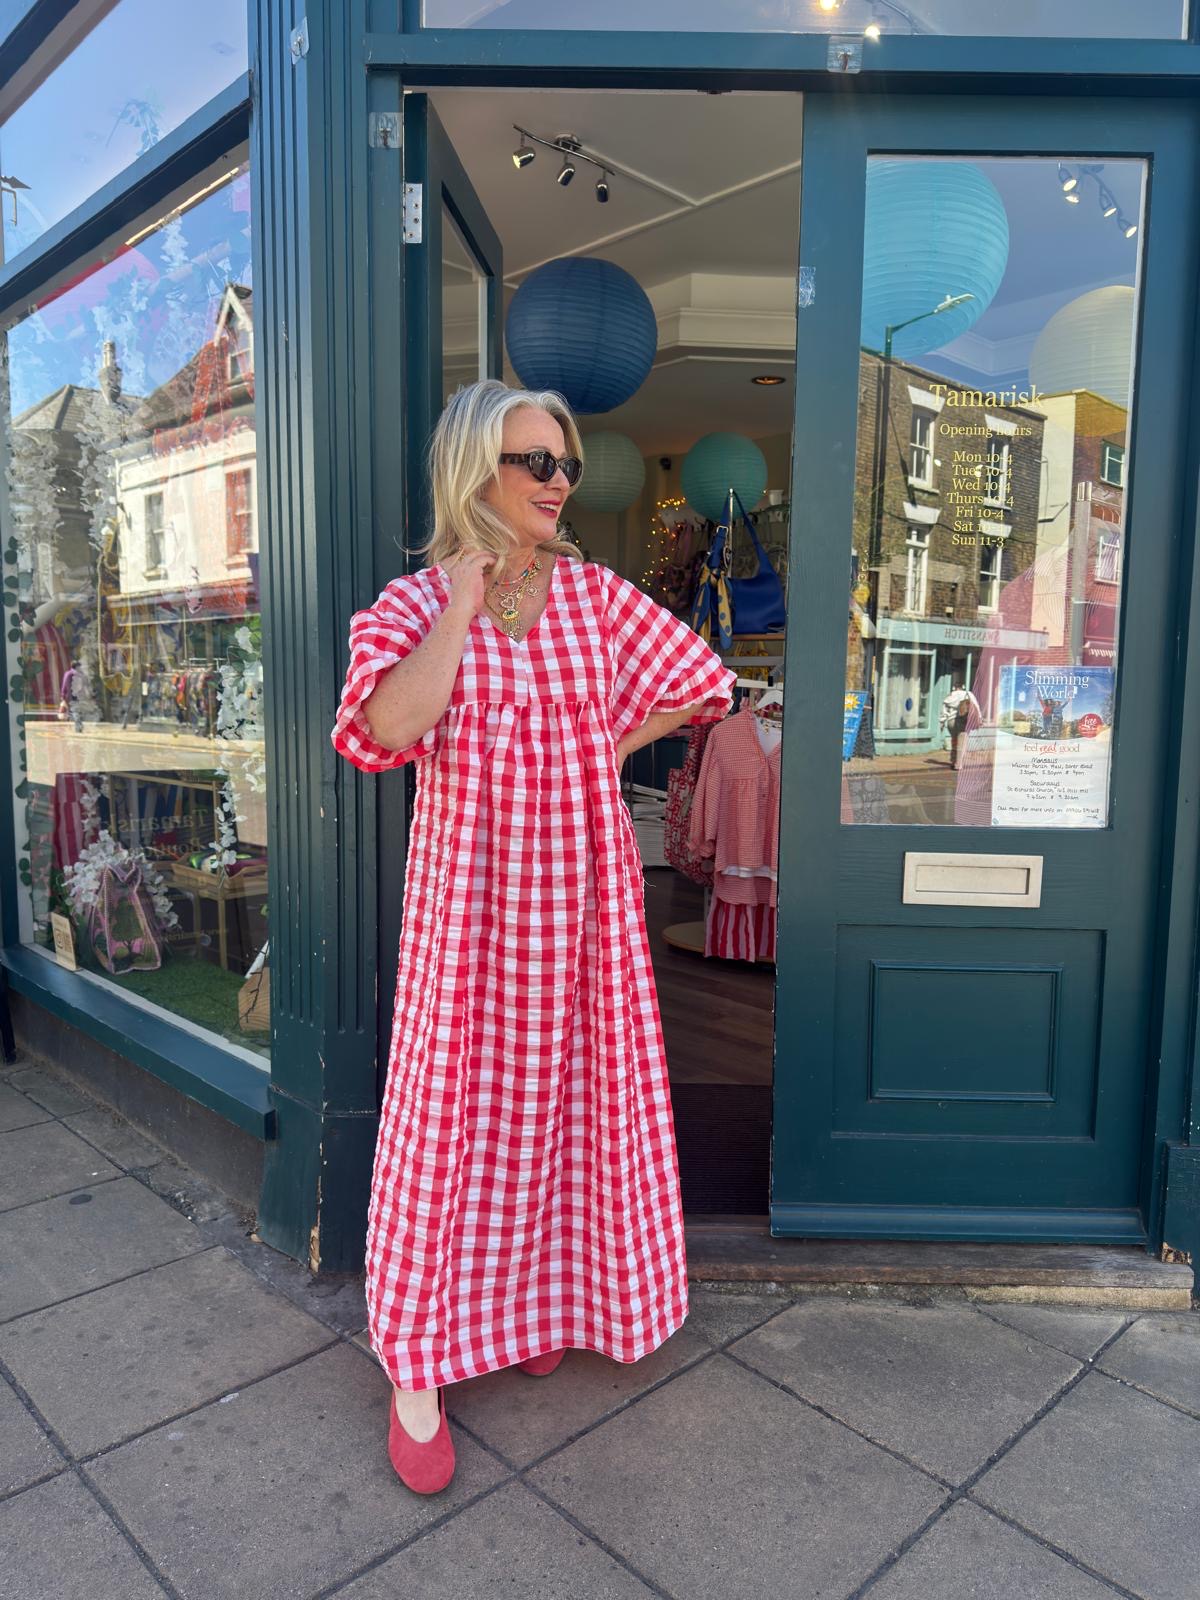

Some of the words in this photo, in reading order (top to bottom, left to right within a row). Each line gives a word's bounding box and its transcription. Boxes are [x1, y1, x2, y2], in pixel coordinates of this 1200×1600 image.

[929, 384, 1044, 408] Tamarisk
[940, 423, 993, 438] Opening
[996, 424, 1032, 437] hours
[953, 450, 982, 462] Mon
[986, 453, 1013, 465] 10-4
[952, 478, 981, 490] Wed
[946, 491, 984, 504] Thurs
[956, 505, 974, 518] Fri
[978, 508, 1005, 520] 10-4
[953, 520, 974, 532] Sat
[952, 533, 976, 546] Sun
[980, 536, 1005, 548] 11-3
[1025, 670, 1090, 689] Slimming
[1037, 685, 1078, 699] World
[1024, 742, 1038, 752] feel
[1039, 742, 1057, 754] real
[1059, 743, 1080, 753] good
